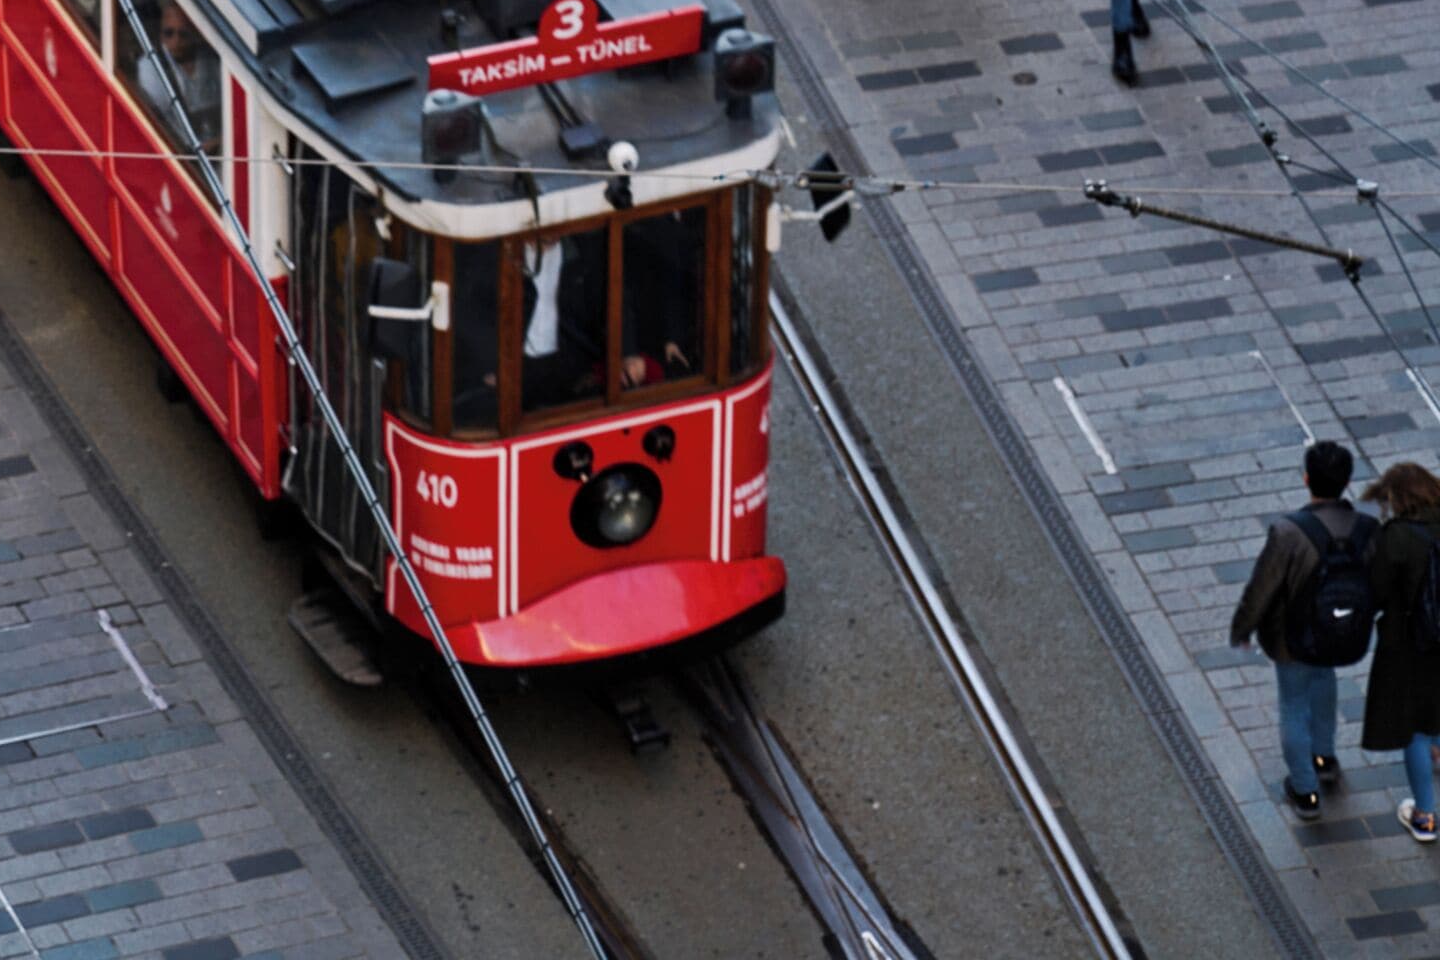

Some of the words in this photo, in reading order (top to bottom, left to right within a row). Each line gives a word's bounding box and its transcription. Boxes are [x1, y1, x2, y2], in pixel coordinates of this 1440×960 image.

[552, 0, 585, 40] 3
[458, 54, 545, 86] TAKSİM
[576, 35, 652, 64] TÜNEL
[416, 470, 458, 508] 410
